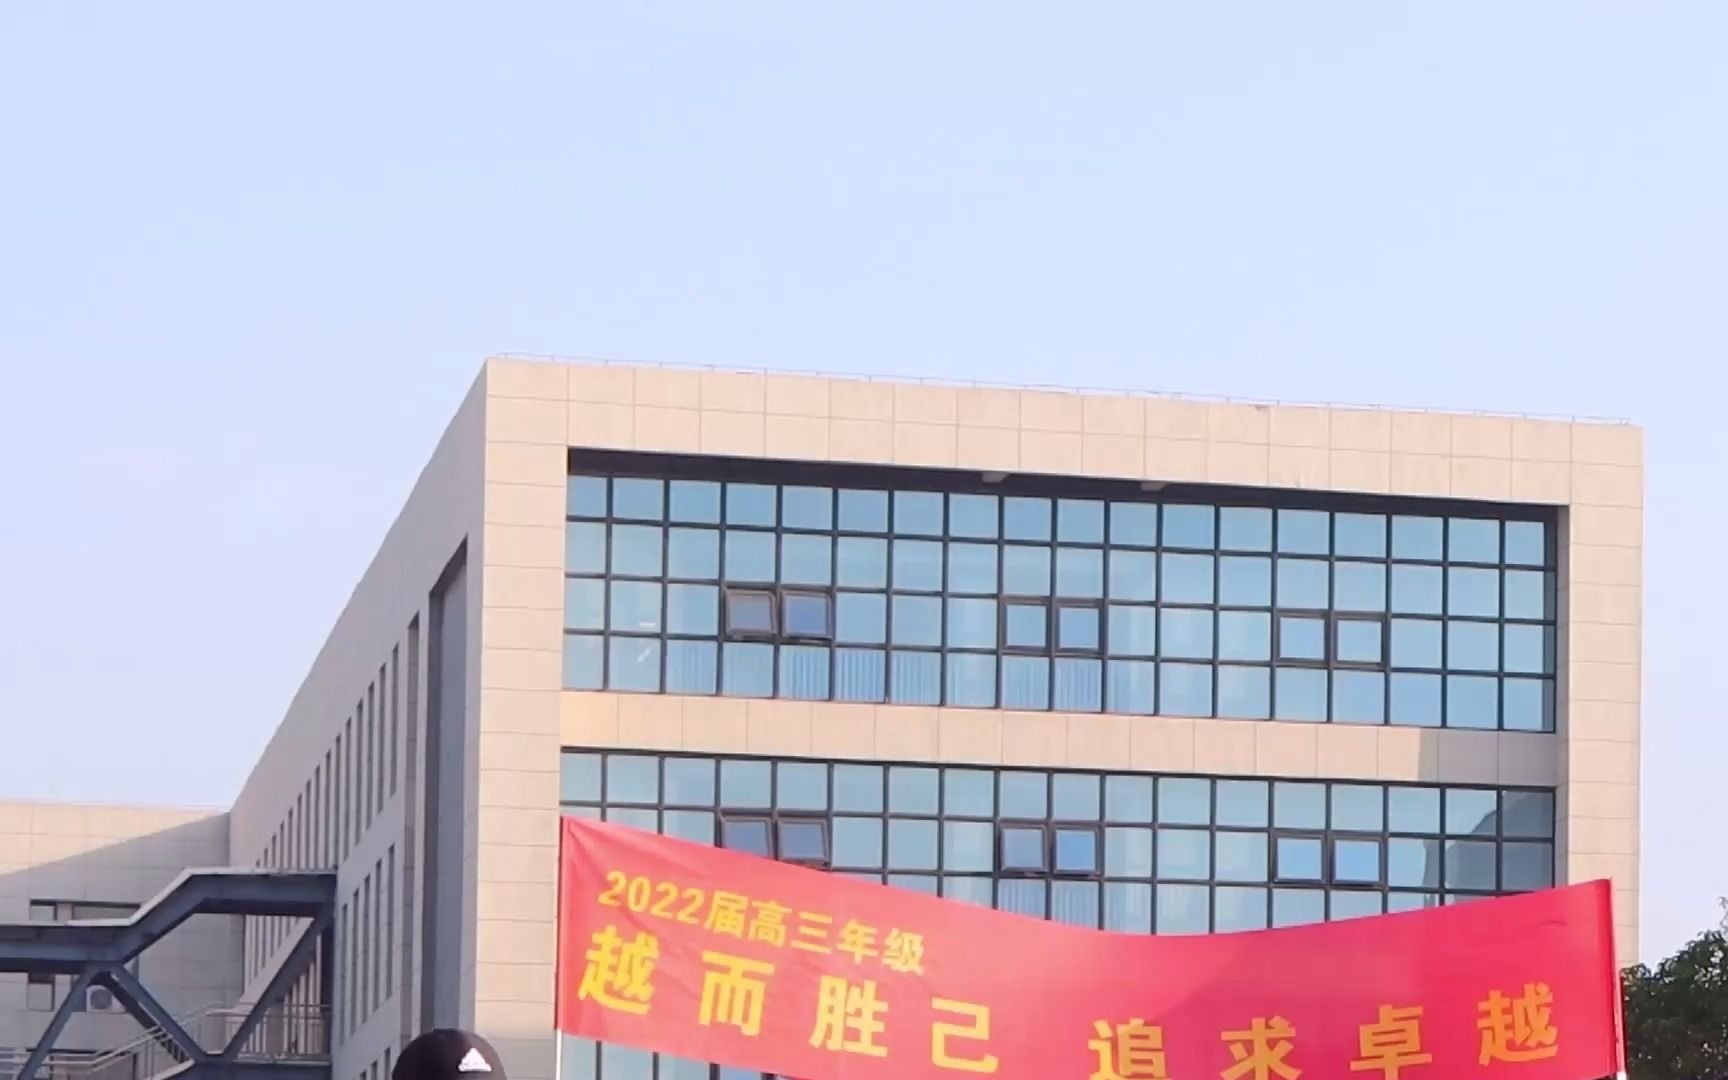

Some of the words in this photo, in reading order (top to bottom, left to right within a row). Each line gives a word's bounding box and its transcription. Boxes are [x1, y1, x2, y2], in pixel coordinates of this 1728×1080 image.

[598, 870, 925, 976] 2022届高三年级
[577, 924, 999, 1075] 越而胜己
